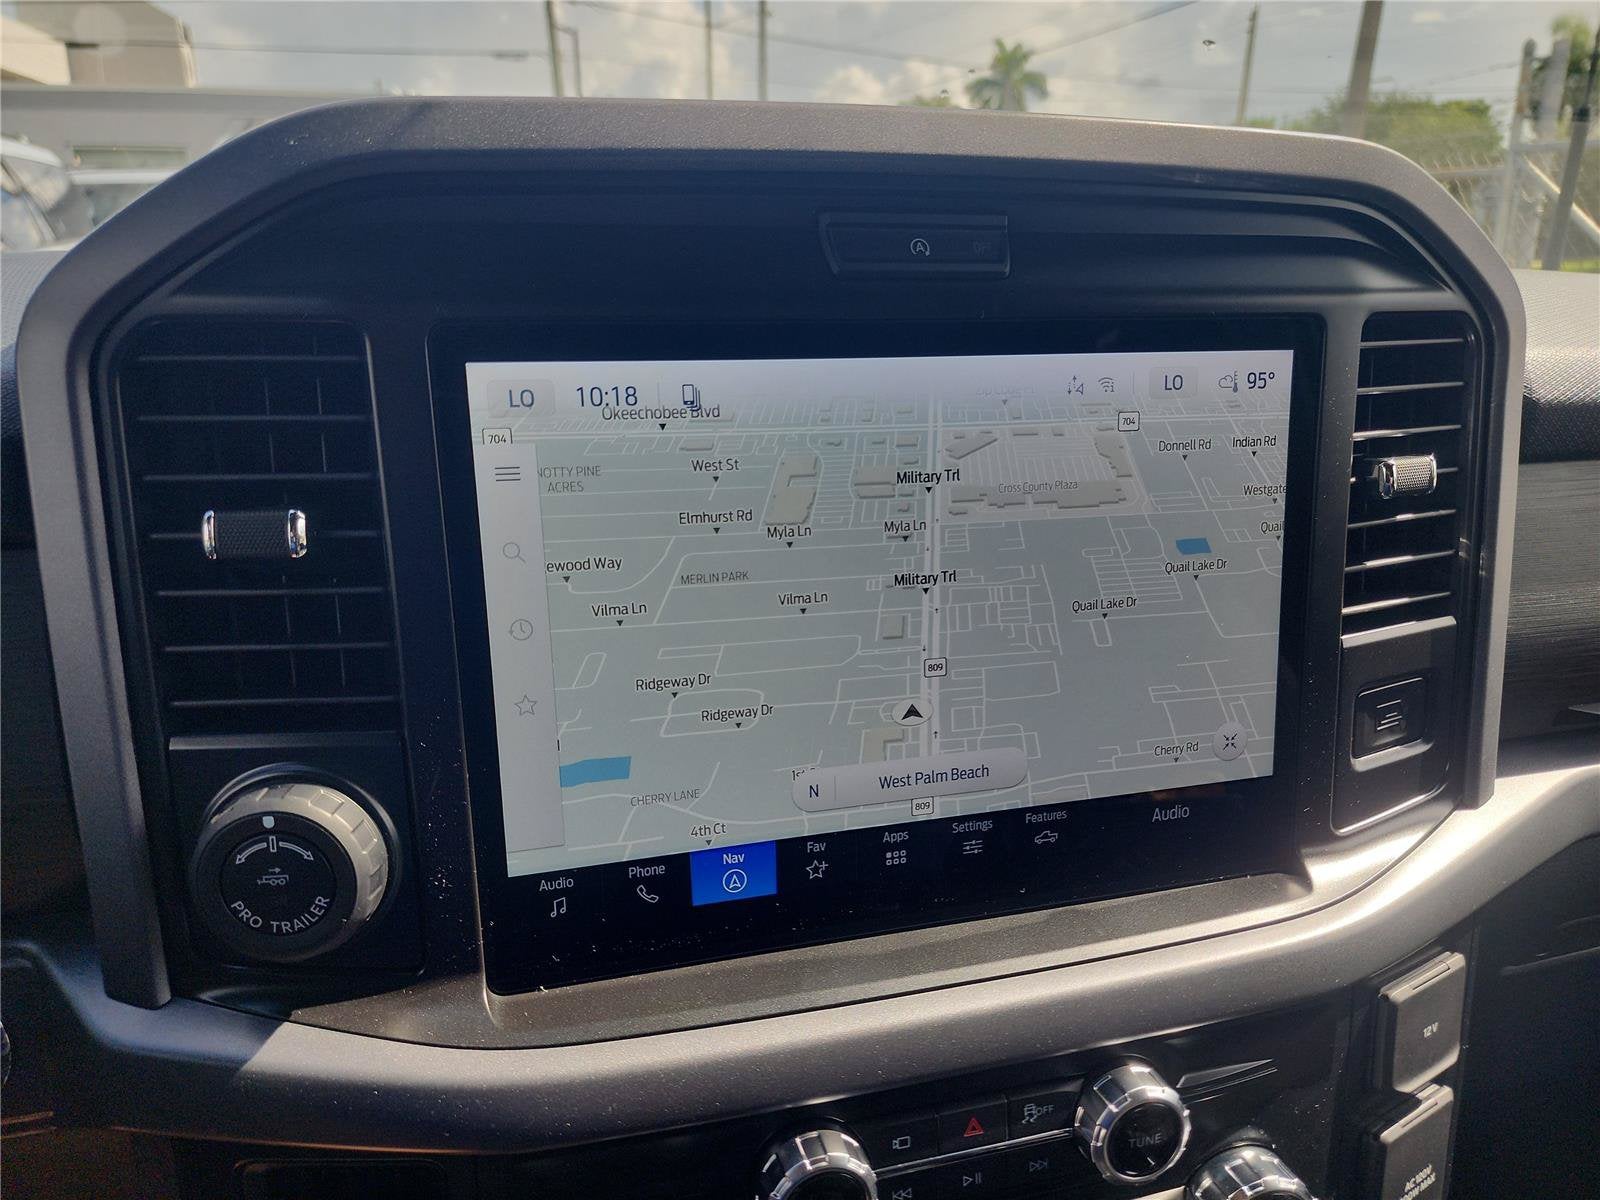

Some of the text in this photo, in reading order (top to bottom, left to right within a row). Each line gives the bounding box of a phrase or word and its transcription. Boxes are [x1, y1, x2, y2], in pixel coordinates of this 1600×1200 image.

[1164, 374, 1183, 391] LO
[1247, 371, 1275, 390] 95°
[508, 388, 535, 408] LO
[576, 385, 638, 408] 10:18
[602, 403, 687, 421] Okeechobee
[1122, 416, 1136, 426] 704
[488, 433, 507, 444] 704
[1158, 438, 1212, 452] Donnell Rd
[1232, 435, 1277, 448] Indian Rd
[576, 465, 601, 478] PINE
[691, 457, 740, 472] West St
[896, 469, 960, 486] Military Trl
[547, 480, 584, 493] ACRES
[998, 479, 1078, 494] Cross County Plaza
[1243, 483, 1287, 497] Westgate
[679, 509, 753, 525] Elmhurst Rd
[767, 525, 812, 540] Myla Ln
[884, 520, 927, 534] Myla Ln
[593, 556, 622, 571] Way
[1164, 558, 1227, 575] Quail Lake Dr
[680, 570, 749, 585] MERLIN PARK
[894, 570, 957, 587] Military Trl
[778, 592, 828, 606] Vilma Ln
[1072, 596, 1138, 614] Quail Lake Dr
[592, 602, 647, 617] Vilma Ln
[927, 662, 944, 673] 809
[635, 673, 712, 692] Ridgeway Dr
[701, 704, 774, 723] Ridgeway Dr
[1154, 741, 1199, 757] Cherry Rd
[879, 764, 989, 790] West Palm Beach
[630, 788, 701, 807] CHERRY LANE
[809, 784, 819, 798] N
[915, 801, 930, 811] 809
[1152, 804, 1190, 823] Audio
[1025, 809, 1067, 824] Features
[690, 822, 727, 838] 4th Ct
[952, 819, 993, 835] Settings
[883, 831, 909, 844] Apps
[807, 841, 826, 853] Fav
[722, 852, 745, 865] Nav
[628, 864, 666, 879] Phone
[539, 876, 574, 892] Audio
[230, 896, 331, 934] PRO TRAILER
[1036, 1104, 1055, 1116] OFF
[1128, 1133, 1162, 1148] TUNE
